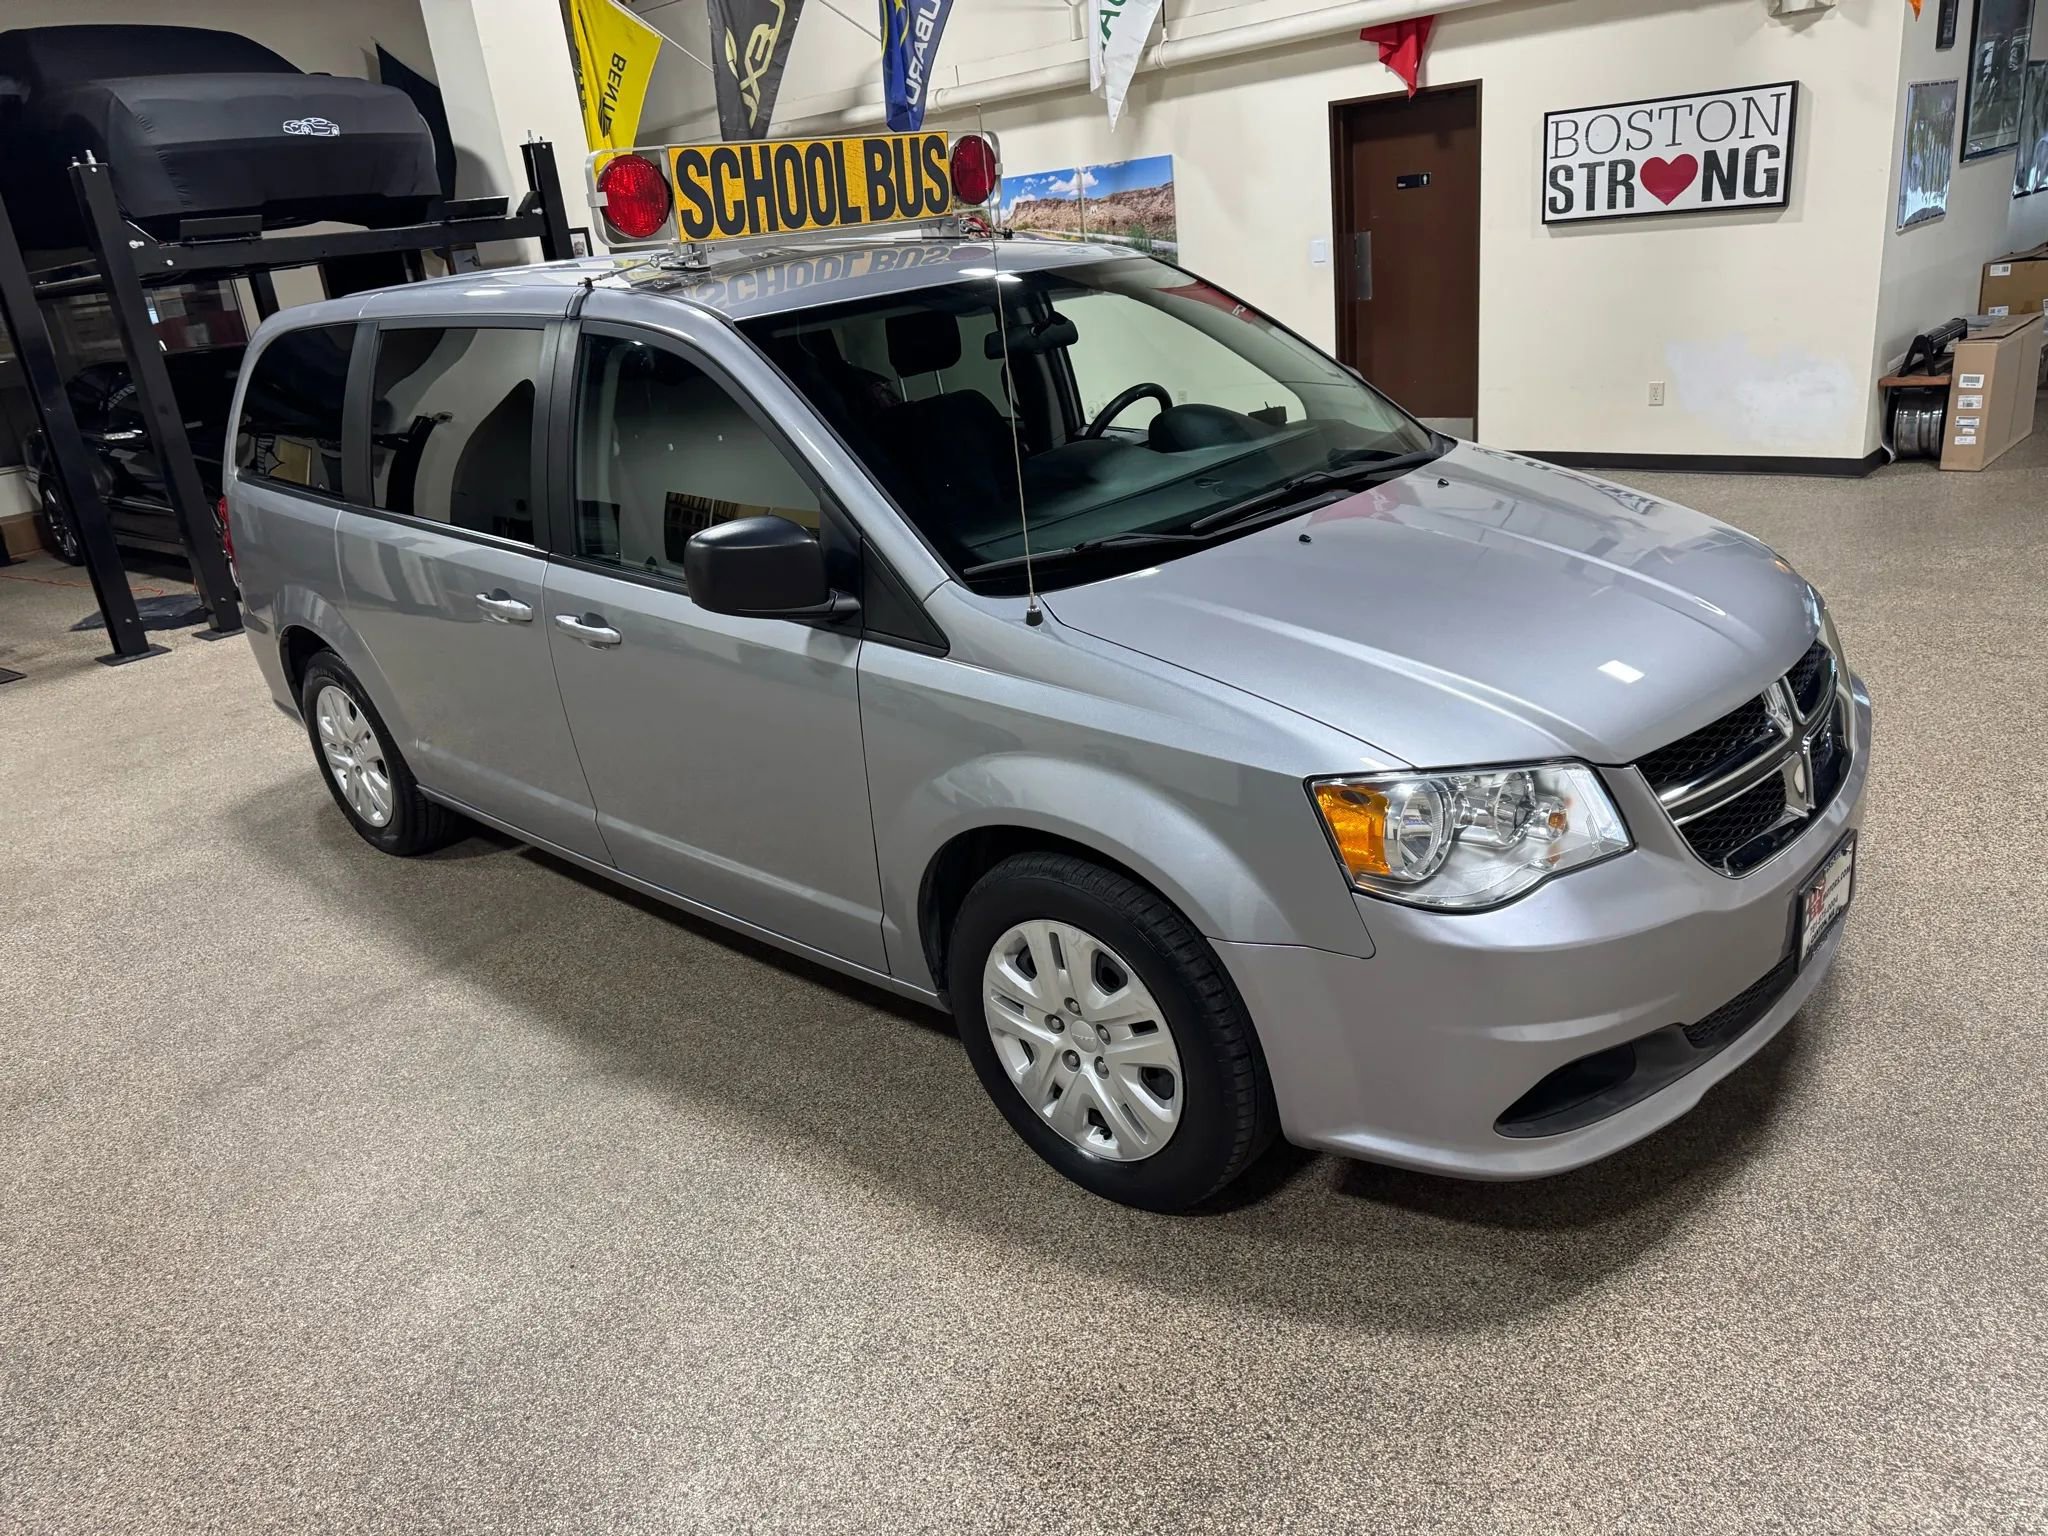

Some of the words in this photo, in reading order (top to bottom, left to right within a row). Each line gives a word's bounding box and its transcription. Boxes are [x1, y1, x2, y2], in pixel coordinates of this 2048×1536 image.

[1550, 92, 1787, 159] BOSTON
[676, 141, 862, 239] SCHOOL
[863, 134, 949, 221] BUS
